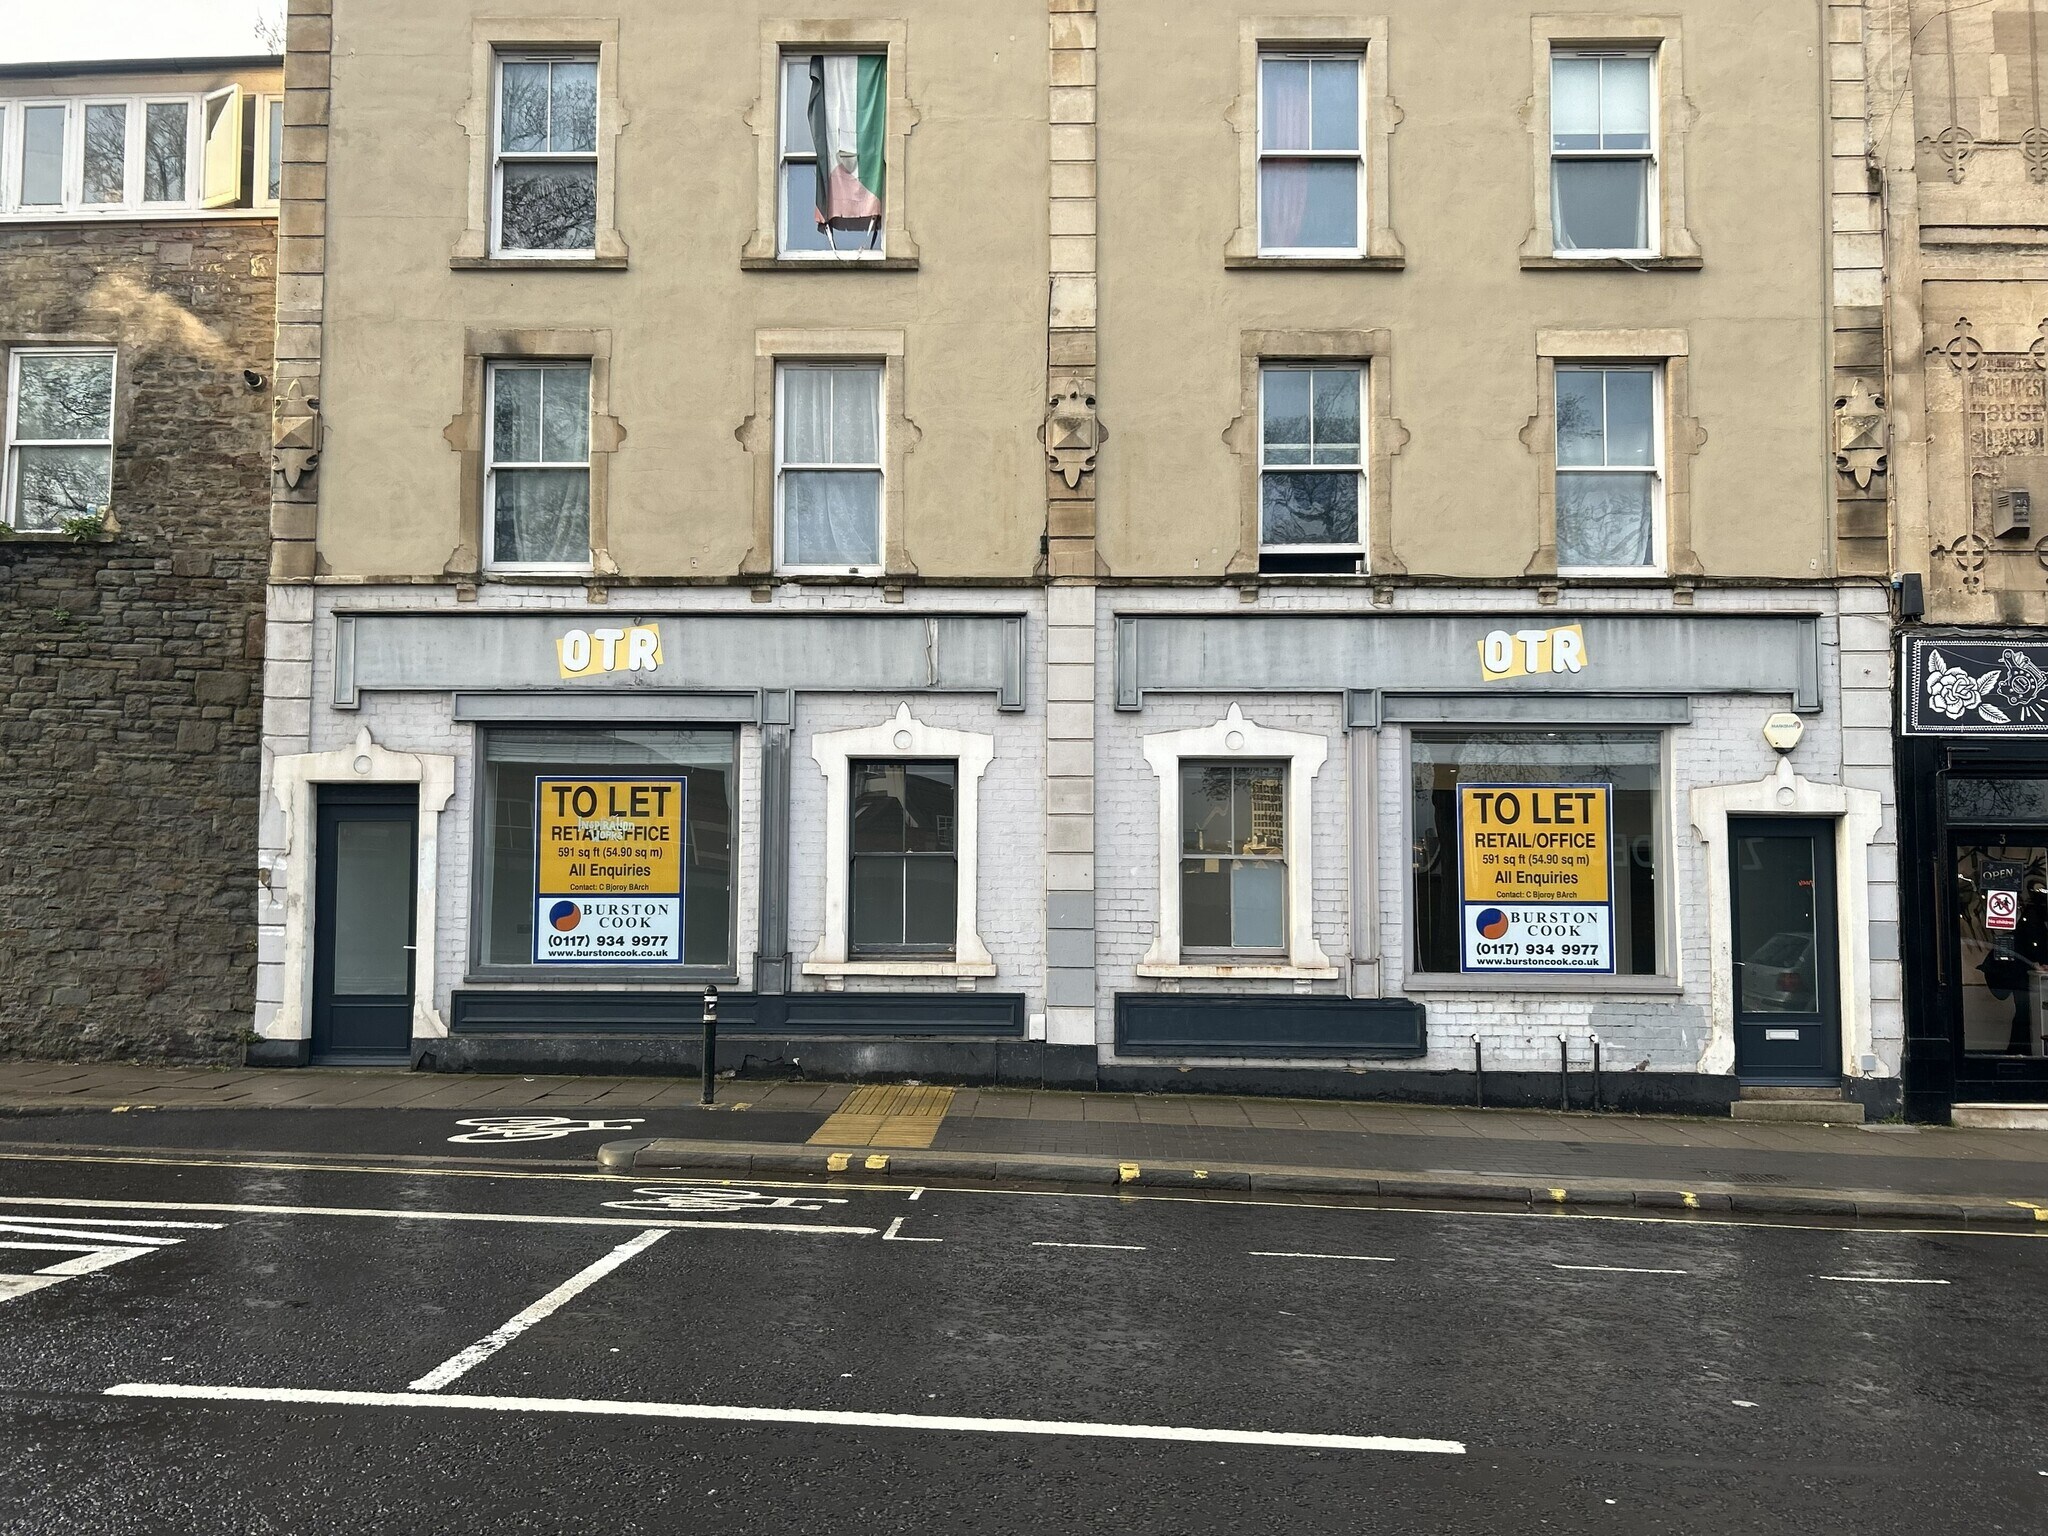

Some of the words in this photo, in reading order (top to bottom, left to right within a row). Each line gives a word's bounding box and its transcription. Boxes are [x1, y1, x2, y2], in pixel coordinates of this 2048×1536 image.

[563, 628, 658, 672] OTR
[1484, 629, 1582, 673] OTR
[551, 786, 597, 817] TO
[609, 786, 671, 817] LET
[1473, 793, 1520, 824] TO
[1533, 793, 1595, 824] LET
[1475, 833, 1595, 848] RETAIL/OFFICE
[1999, 834, 2006, 844] 3
[558, 848, 574, 857] 591
[578, 849, 590, 859] sq
[593, 847, 599, 857] ft
[603, 847, 632, 859] (54.90
[635, 849, 647, 859] sq
[650, 847, 662, 859] m)
[1482, 855, 1499, 864] 591
[1504, 856, 1515, 866] sq
[1519, 854, 1525, 864] ft
[1528, 854, 1558, 866] (54.90
[1562, 856, 1573, 866] sq
[1577, 854, 1589, 866] m)
[569, 864, 587, 876] All
[591, 864, 650, 878] Enquiries
[1983, 868, 2014, 880] OPEN
[1495, 871, 1512, 883] All
[1517, 871, 1578, 886] Enquiries
[606, 884, 627, 892] Bjoroy
[1533, 892, 1554, 900] Bjoroy
[583, 904, 668, 915] BURSTON
[600, 917, 651, 928] COOK
[1511, 912, 1597, 923] BURSTON
[1528, 925, 1581, 936] COOK
[549, 935, 590, 947] (0117)
[597, 936, 624, 946] 934
[632, 936, 668, 946] 9977
[549, 949, 668, 957] www.burstoncook.co.uk
[1477, 943, 1518, 955] (0117)
[1526, 944, 1554, 954] 934
[1562, 944, 1598, 955] 9977
